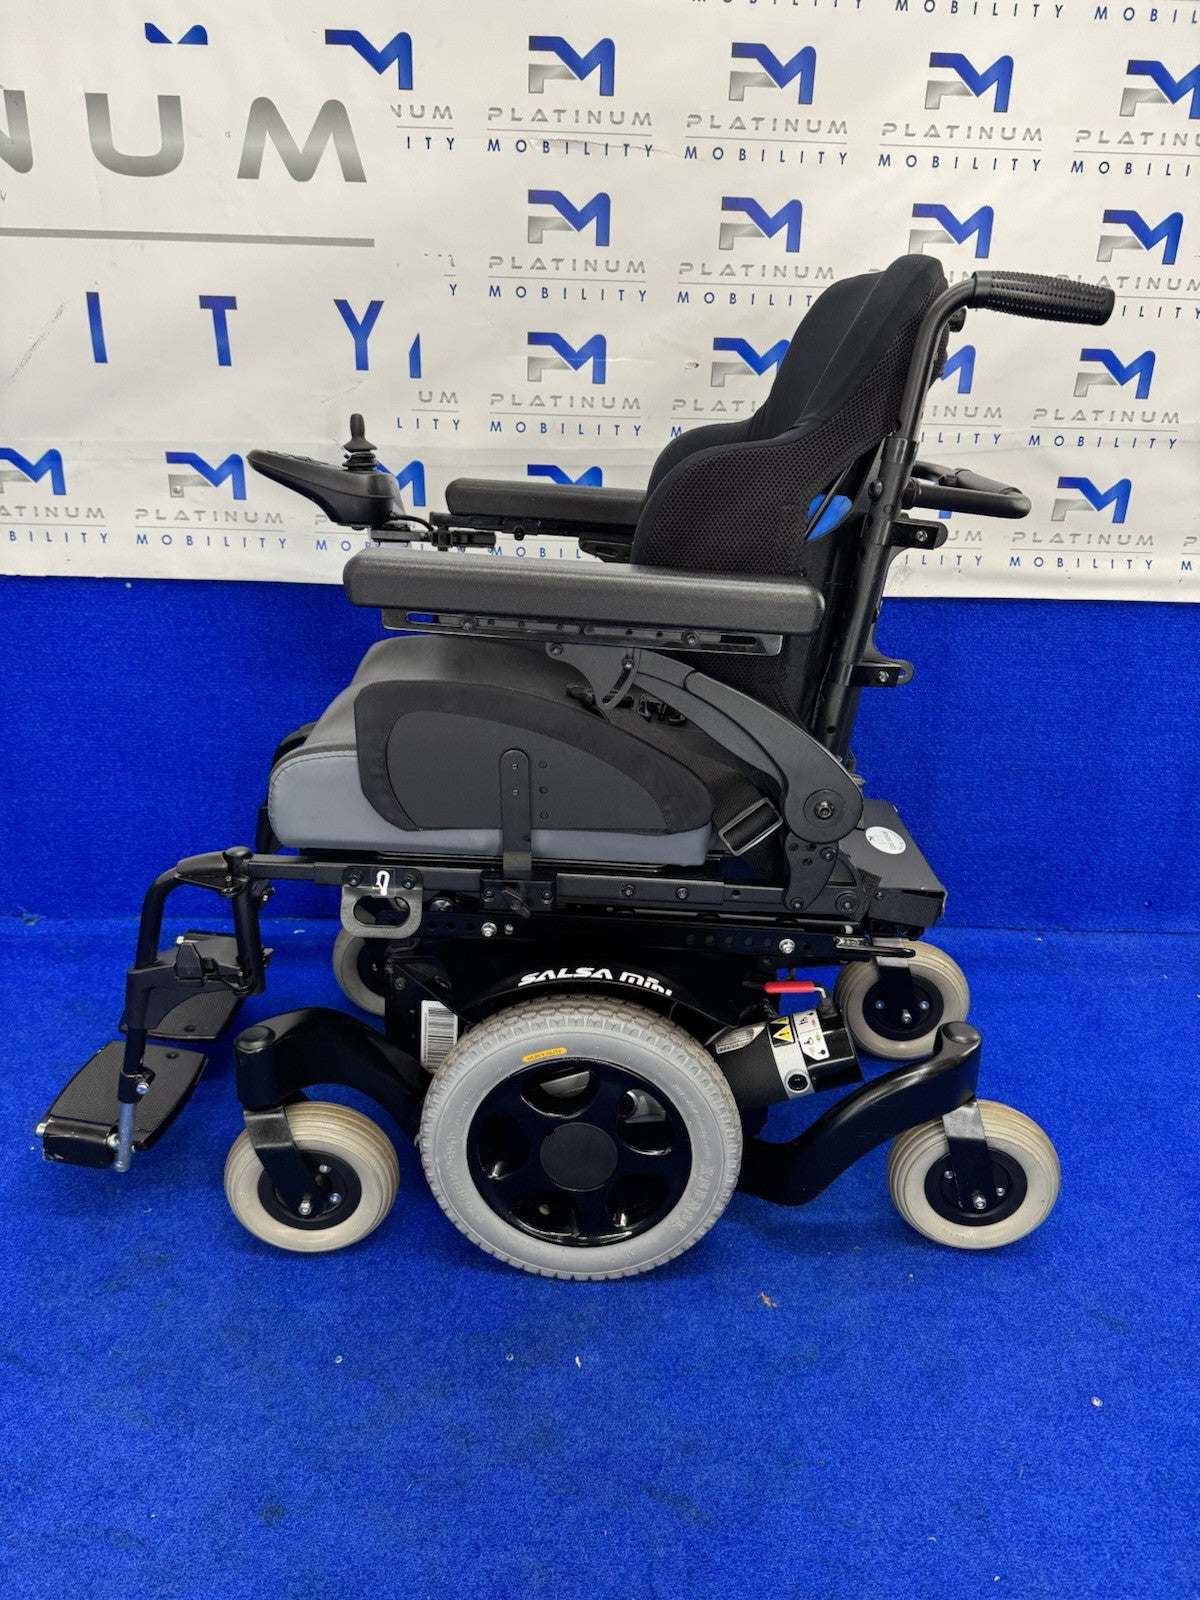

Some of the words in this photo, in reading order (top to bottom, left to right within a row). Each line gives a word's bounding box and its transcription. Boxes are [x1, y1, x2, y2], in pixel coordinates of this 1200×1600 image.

[487, 106, 653, 127] PLATINUM
[686, 114, 849, 135] PLATINUM
[881, 122, 1043, 142] PLATINUM
[486, 138, 654, 158] MOBILITY
[684, 146, 848, 165] MOBILITY
[878, 154, 1042, 172] MOBILITY
[488, 255, 647, 274] PLATINUM
[679, 262, 835, 280] PLATINUM
[488, 285, 648, 302] MOBILITY
[490, 393, 641, 410] PLATINUM
[1032, 408, 1180, 425] PLATINUM
[490, 421, 642, 437] MOBILITY
[1028, 435, 1178, 450] MOBILITY
[135, 508, 284, 524] PLATINUM
[136, 534, 287, 549] MOBILITY
[1011, 532, 1154, 547] PLATINUM
[1009, 556, 1153, 570] MOBILITY
[517, 967, 613, 987] SALSA
